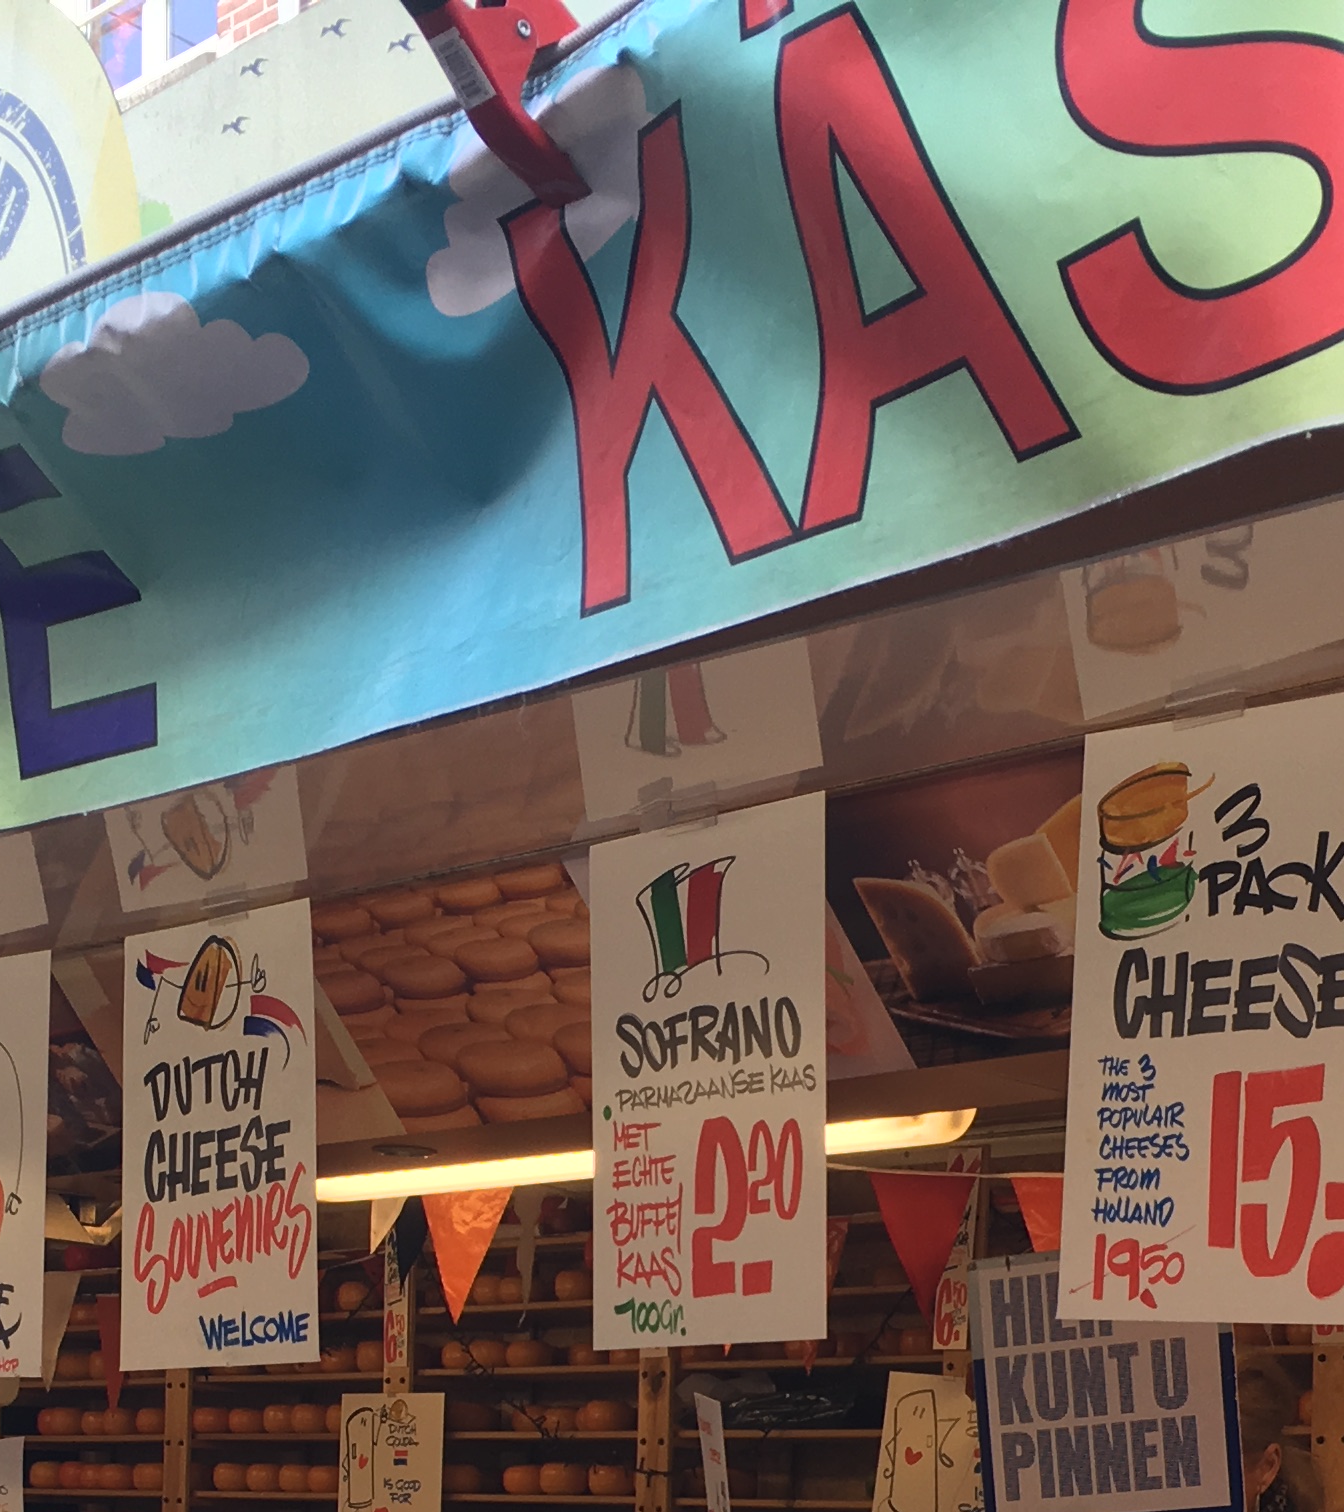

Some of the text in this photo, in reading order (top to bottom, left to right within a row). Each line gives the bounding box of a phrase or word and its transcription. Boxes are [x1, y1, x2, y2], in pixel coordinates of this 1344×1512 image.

[1214, 784, 1269, 857] 3
[615, 996, 802, 1079] SOFRANO
[143, 1047, 269, 1122] DUTCH
[769, 1064, 818, 1095] KAAS
[1098, 1054, 1156, 1081] THE 3
[1101, 1082, 1154, 1102] MOST
[1097, 1102, 1185, 1131] POPULAIR
[613, 1119, 661, 1152] MET
[1098, 1132, 1190, 1161] CHEESES
[143, 1118, 291, 1203] CHEESE
[613, 1155, 676, 1190] ECHTE
[1094, 1166, 1160, 1192] FROM
[1091, 1196, 1174, 1228] HOLLAND
[133, 1162, 312, 1315] SOUVENIRS
[616, 1249, 682, 1297] KAAS
[199, 1310, 309, 1350] WELCOME
[995, 1337, 1189, 1427] KUNT U
[1001, 1415, 1202, 1502] PINNEN
[383, 1478, 422, 1492] IS GOOD
[389, 1492, 412, 1505] FOR
